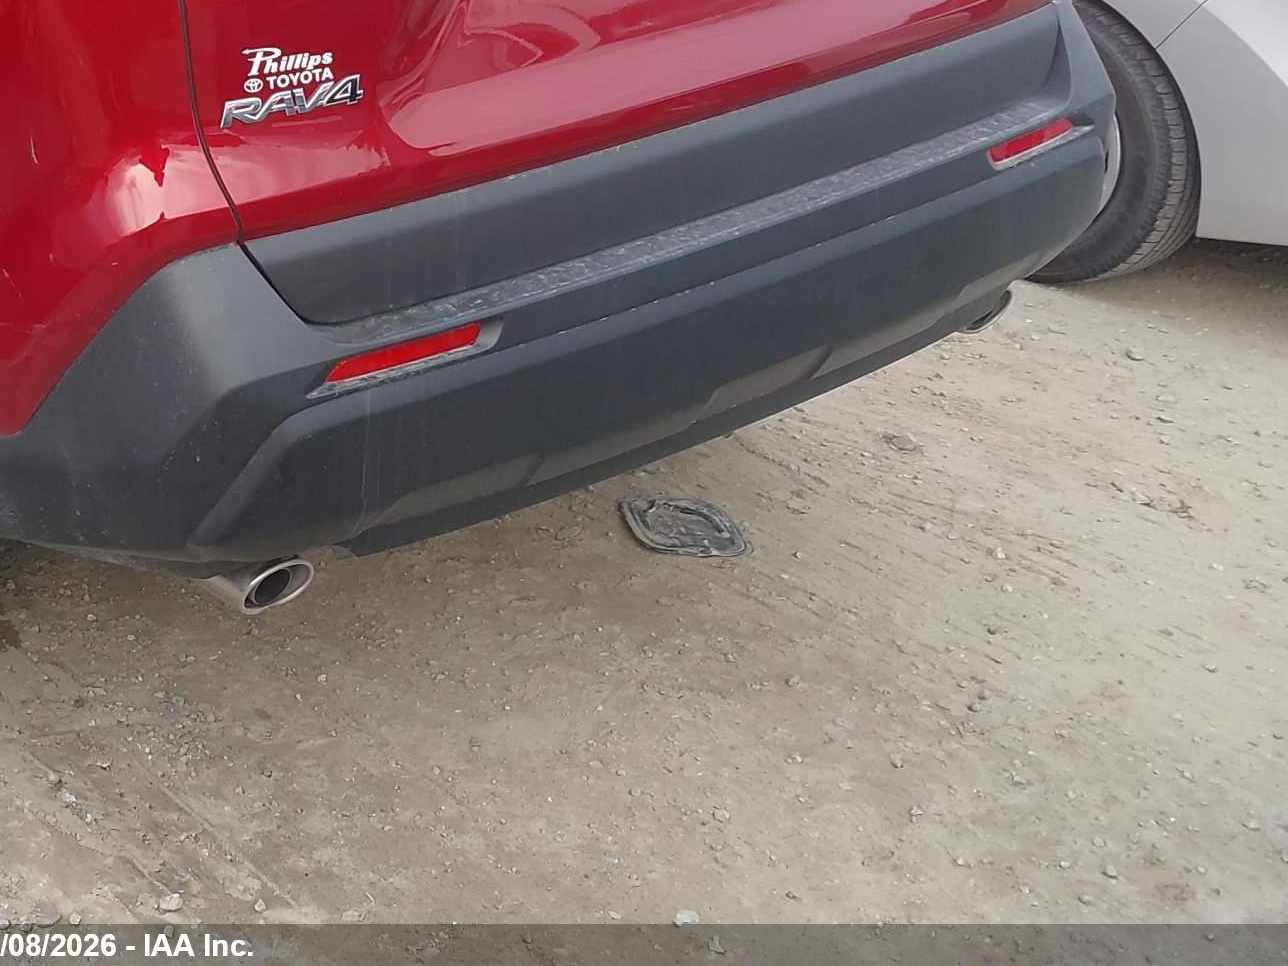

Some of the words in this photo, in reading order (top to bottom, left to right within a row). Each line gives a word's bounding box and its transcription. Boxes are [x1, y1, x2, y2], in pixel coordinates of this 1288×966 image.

[241, 47, 334, 77] Phillips
[265, 67, 335, 90] TOYOTA
[220, 74, 364, 129] RAV4
